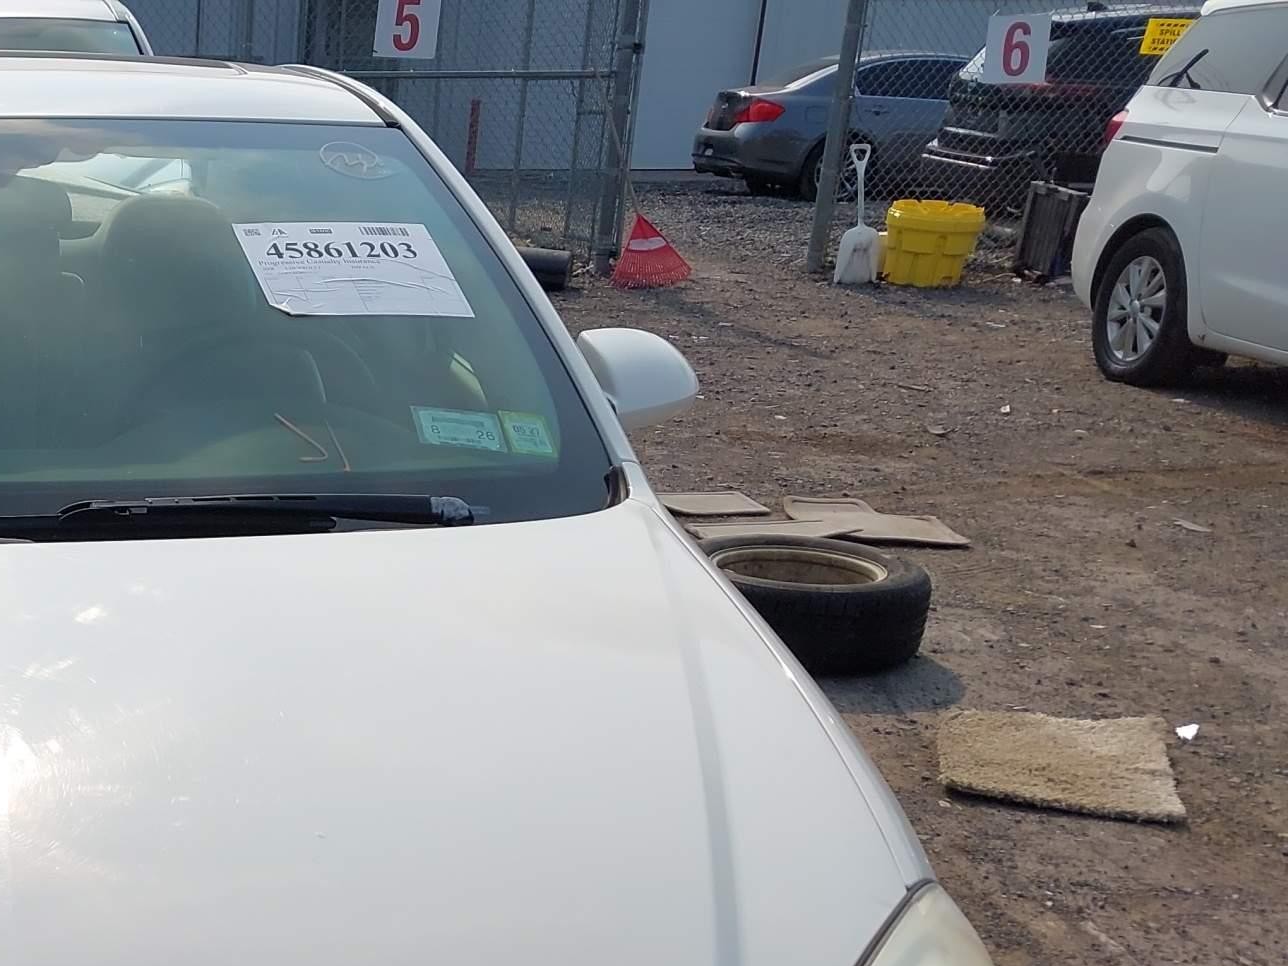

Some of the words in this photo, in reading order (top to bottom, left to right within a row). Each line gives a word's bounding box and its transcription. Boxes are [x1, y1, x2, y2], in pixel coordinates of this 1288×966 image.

[393, 0, 421, 51] 5
[1159, 28, 1181, 36] SPILL
[1002, 21, 1032, 77] 6
[265, 240, 418, 259] 45861203
